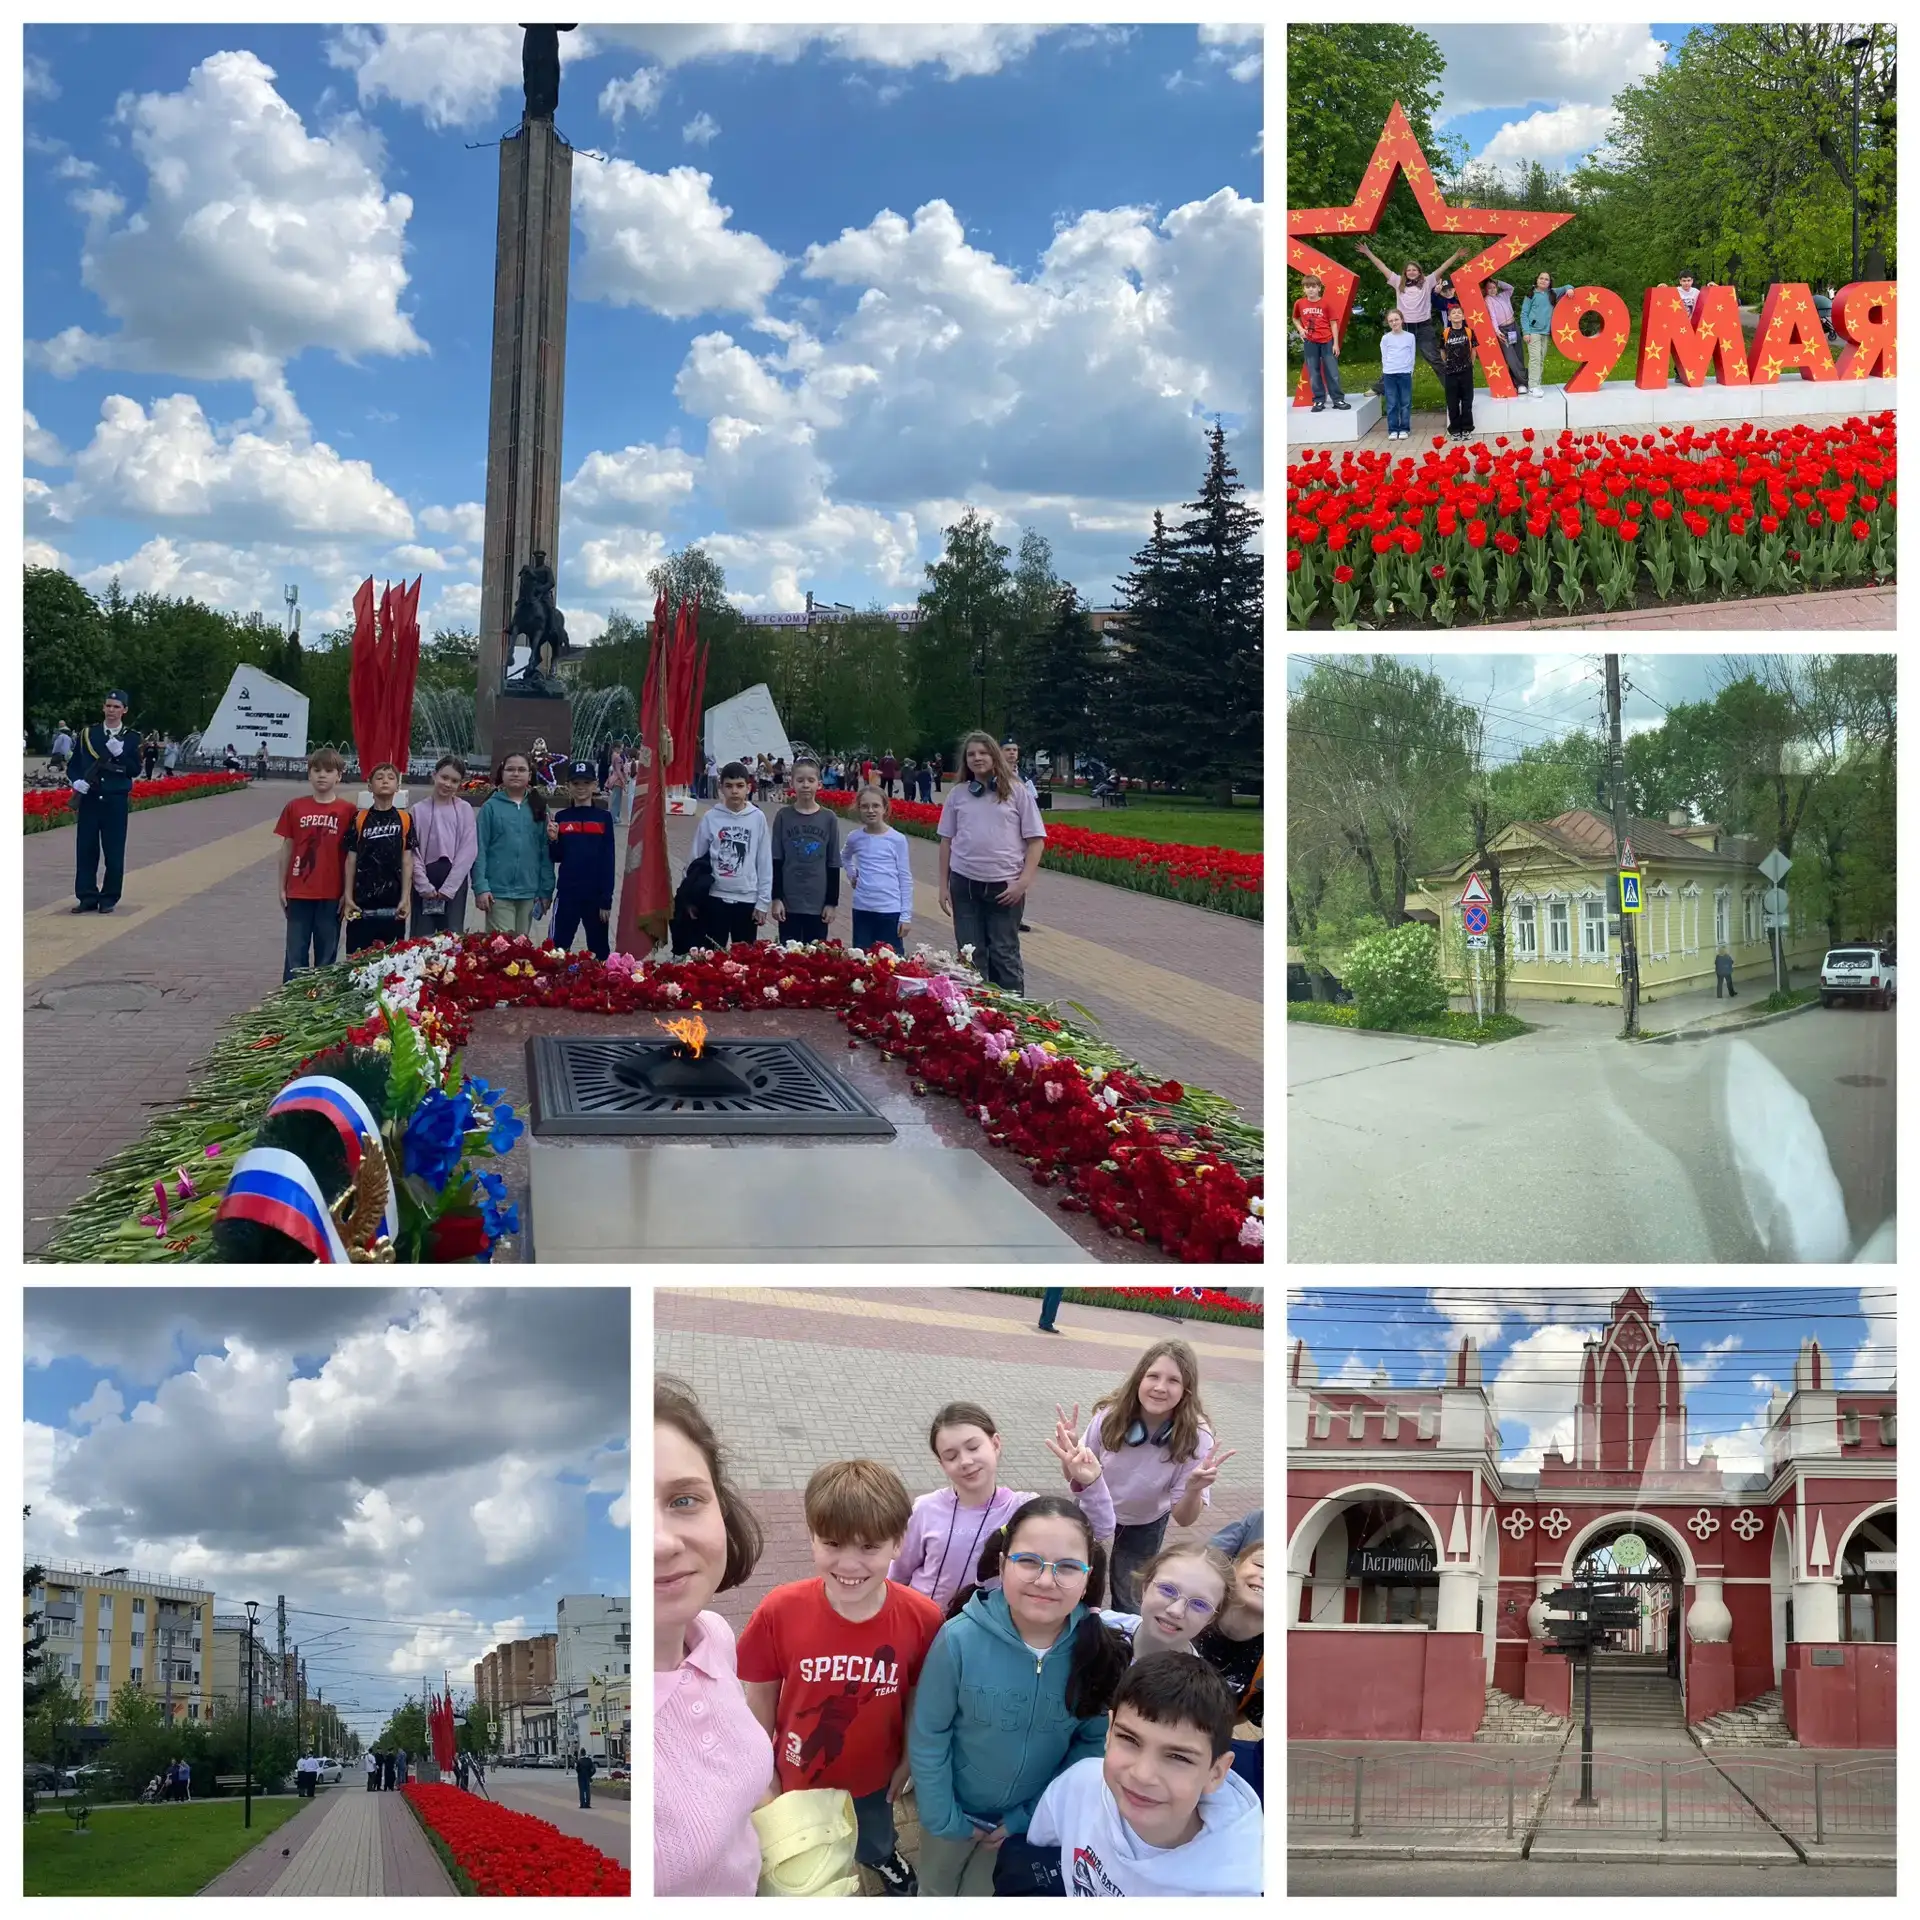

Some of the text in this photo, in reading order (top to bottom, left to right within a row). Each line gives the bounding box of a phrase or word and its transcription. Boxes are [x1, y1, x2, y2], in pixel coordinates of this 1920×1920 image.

[1551, 281, 1897, 394] 9 МАЯ
[575, 763, 586, 772] 13
[300, 814, 338, 830] SPECIAL
[294, 856, 300, 867] 3
[800, 1655, 899, 1685] SPECIAL
[875, 1686, 898, 1697] TEAM
[787, 1731, 802, 1754] 3
[1082, 1845, 1126, 1897] FINAL BATT
